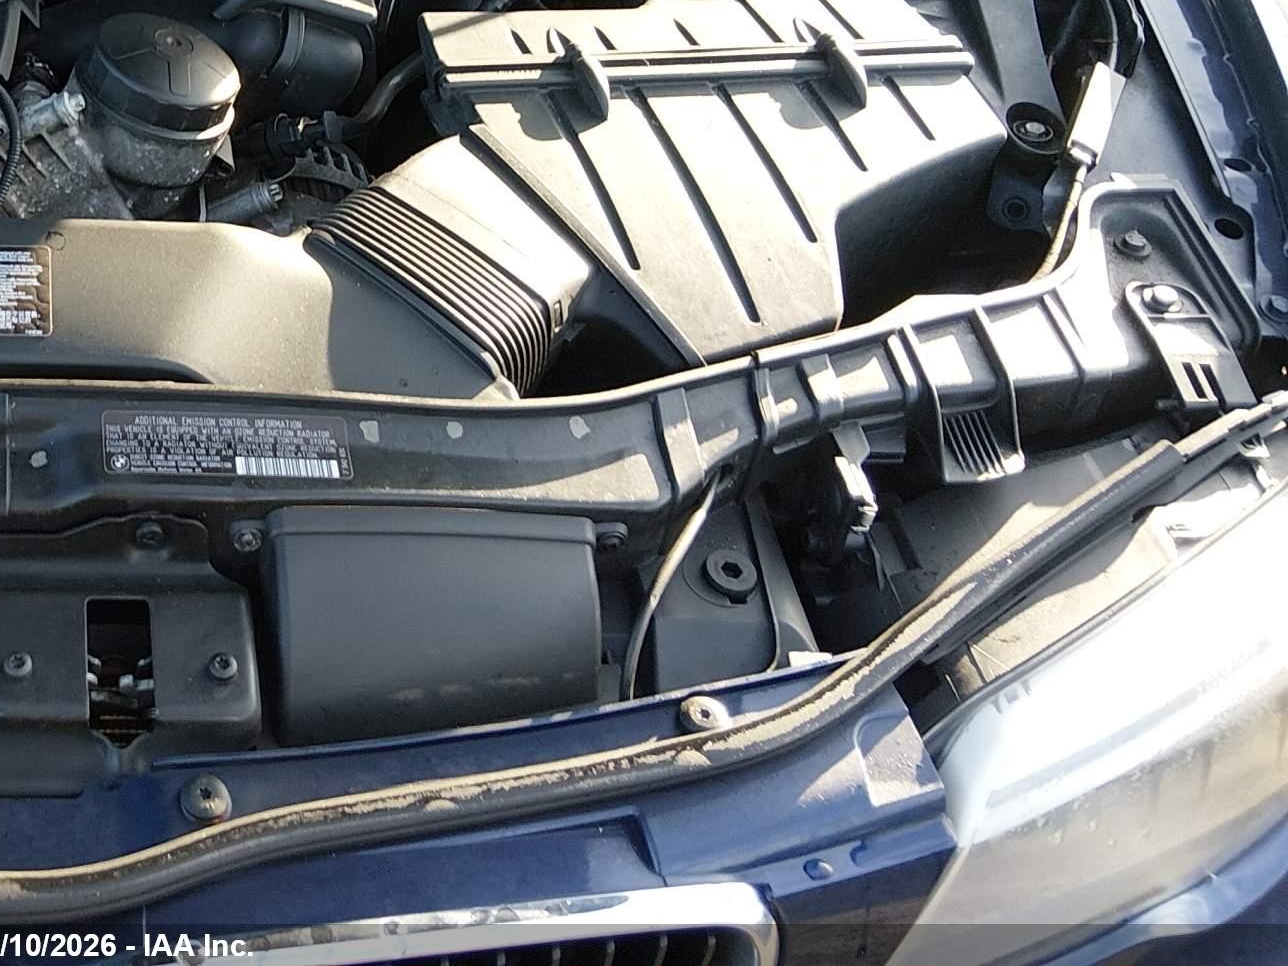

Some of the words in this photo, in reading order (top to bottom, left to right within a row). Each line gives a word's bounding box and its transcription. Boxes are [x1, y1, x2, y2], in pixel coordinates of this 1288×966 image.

[134, 416, 177, 425] ADDITIONAL
[181, 416, 216, 427] EMISSION
[219, 417, 250, 427] CONTROL
[254, 418, 303, 429] INFORMATION
[105, 424, 121, 432] THIS
[124, 425, 152, 433] VEHICLE
[201, 426, 219, 434] WITH
[222, 427, 232, 435] AN
[258, 428, 294, 436] REDUCTION
